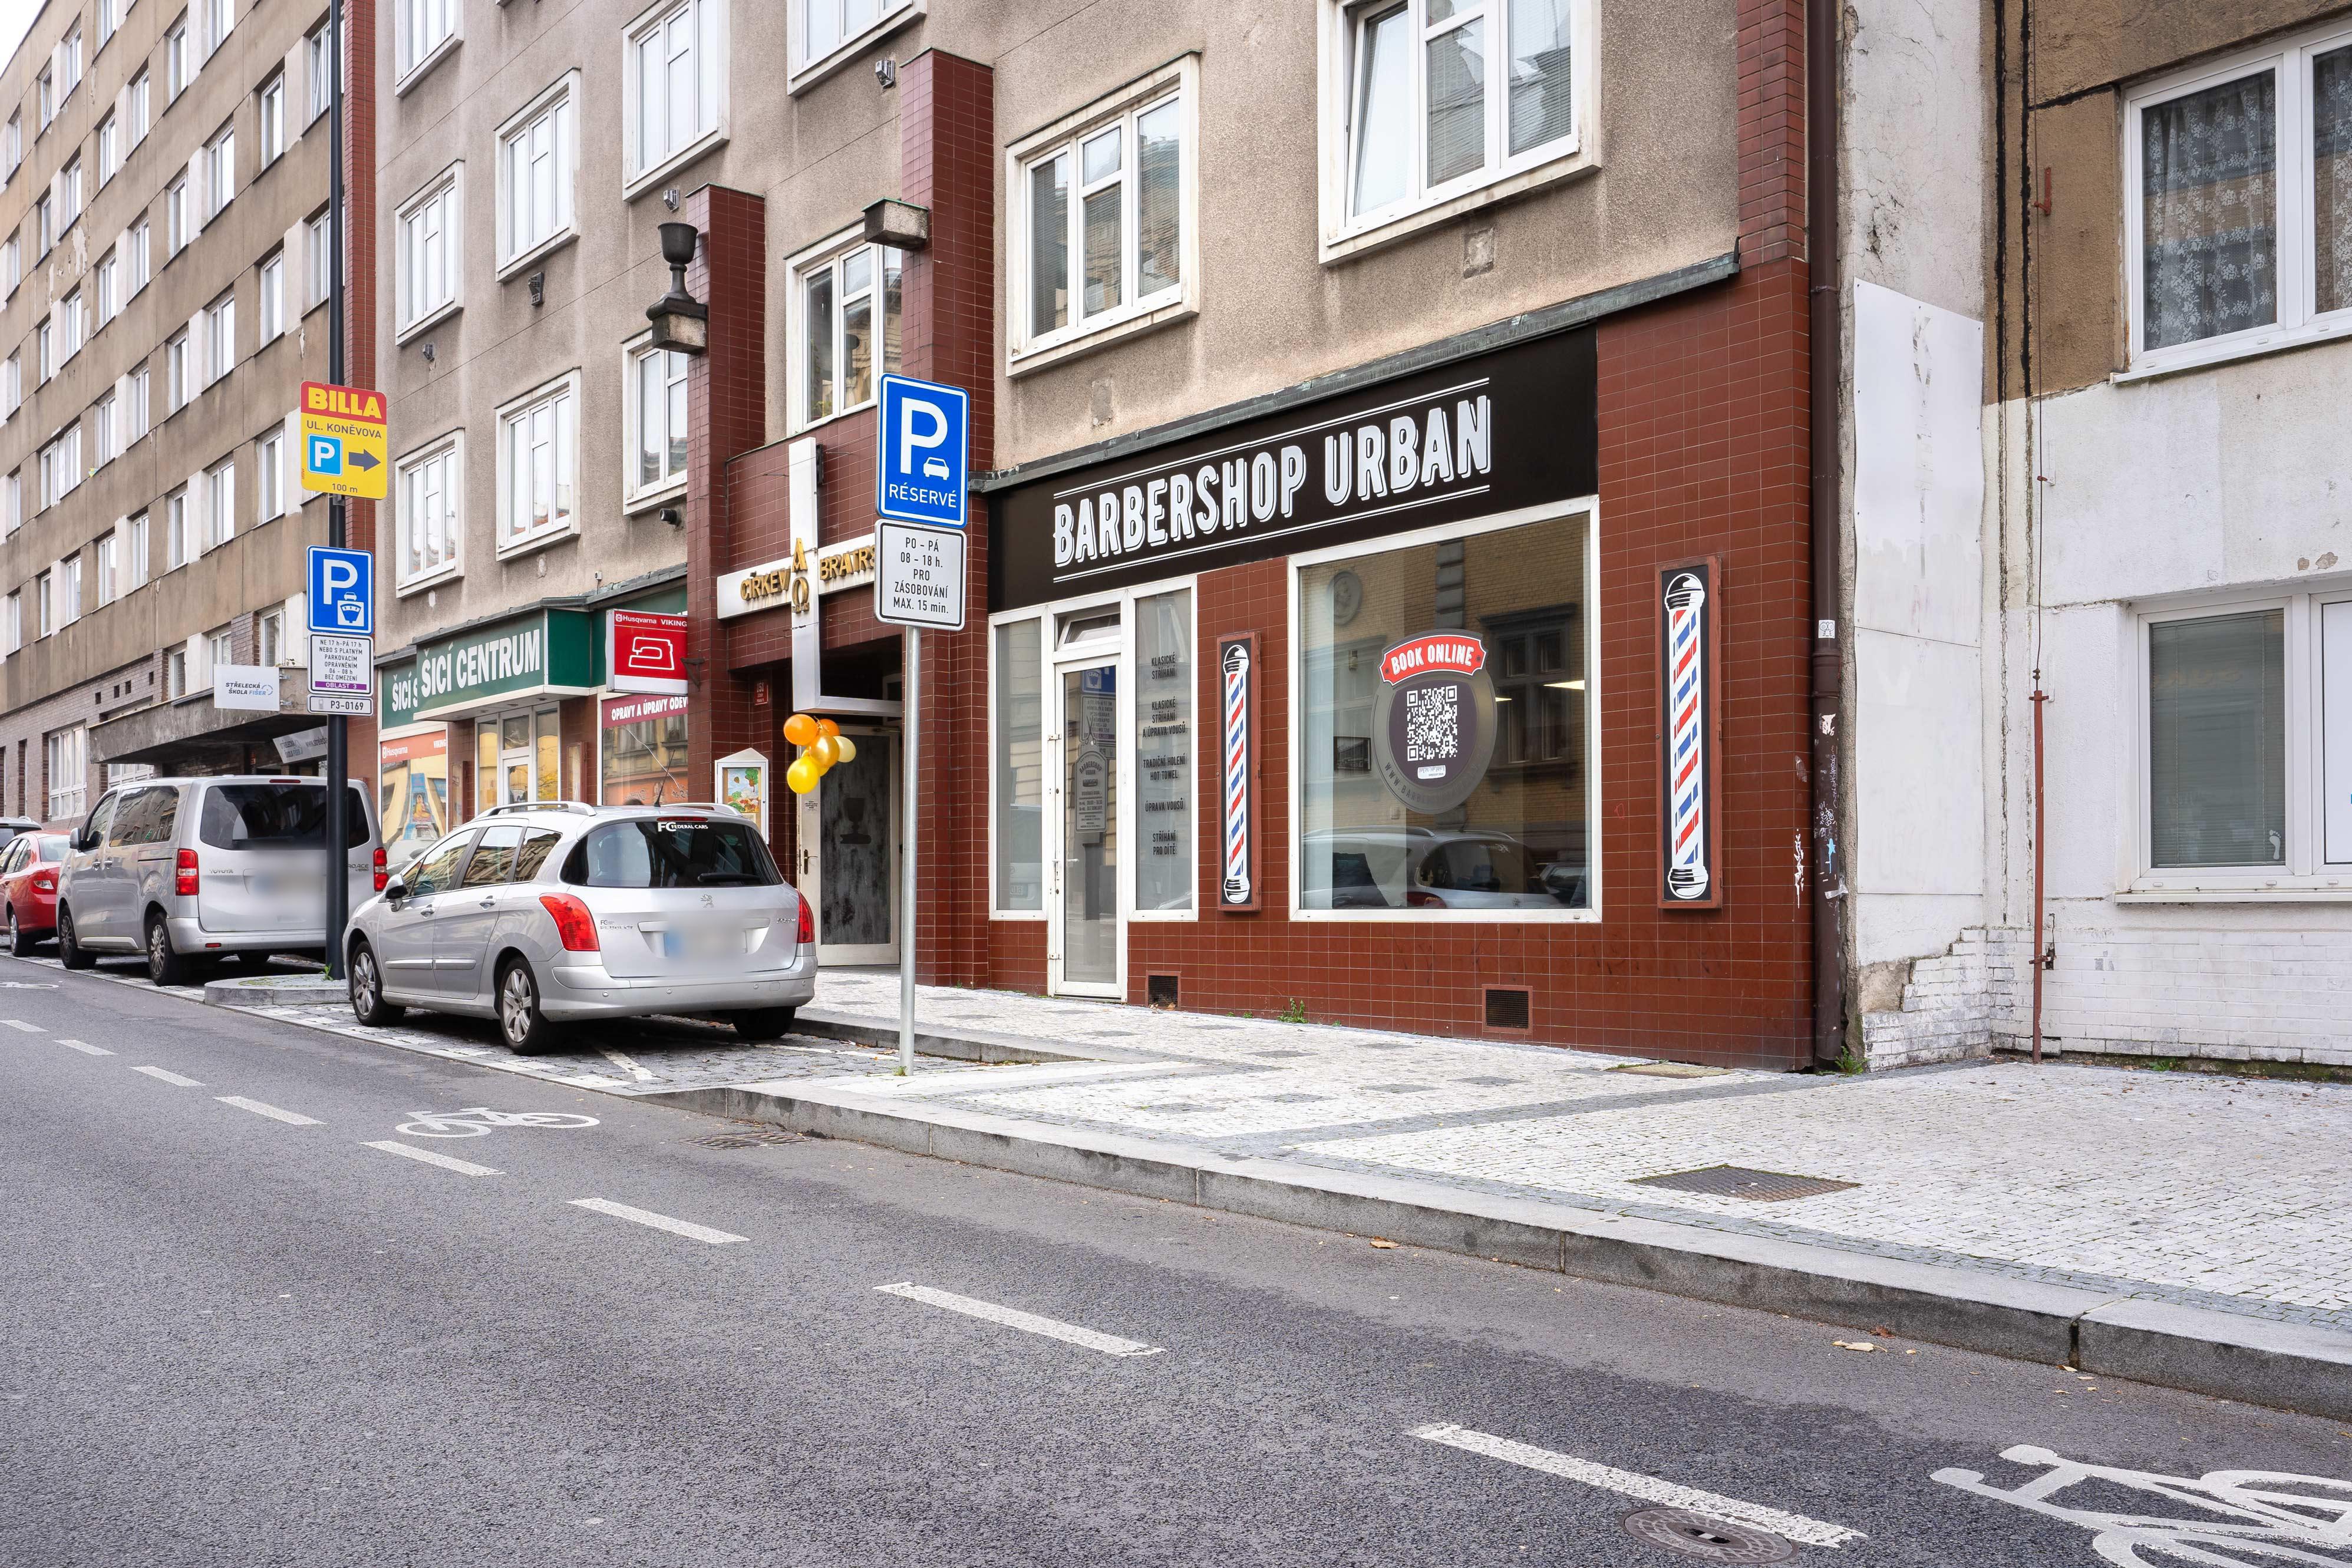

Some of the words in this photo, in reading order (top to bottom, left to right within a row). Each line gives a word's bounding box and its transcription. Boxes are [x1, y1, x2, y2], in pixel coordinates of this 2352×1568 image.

[308, 387, 382, 419] BILLA
[306, 420, 323, 430] UL.
[326, 423, 382, 439] KONĚVOVA
[900, 397, 948, 474] P
[315, 441, 335, 467] P
[332, 483, 347, 491] 100
[1053, 445, 1306, 568] BARBERSHOP
[1324, 395, 1492, 506] URBAN
[889, 482, 957, 508] RÉSERVÉ
[906, 537, 916, 549] PO
[928, 539, 939, 552] PÁ
[900, 552, 911, 563] 08
[922, 554, 932, 566] 18
[935, 556, 943, 568] h.
[323, 559, 358, 605] P
[913, 569, 930, 581] PRO
[895, 580, 949, 599] ZÁSOBOVÁNÍ
[893, 596, 914, 609] MAX.
[918, 599, 927, 611] 15
[931, 602, 949, 614] min.
[623, 615, 657, 624] Husqvarna
[661, 619, 687, 627] VIKING
[421, 642, 453, 698] ŠICÍ
[456, 629, 540, 689] CENTRUM
[1152, 652, 1176, 666] KLASICKÉ
[1391, 646, 1424, 675] BOOK
[1427, 643, 1475, 666] ONLINE
[1152, 665, 1175, 679] STŘÍHÁNÍ
[392, 671, 412, 712] ŠICÍ
[331, 700, 364, 710] P3-0169
[611, 705, 635, 721] OPRAVY
[637, 703, 642, 716] A
[643, 699, 668, 715] ÚPRAVY
[1152, 696, 1176, 711] KLASICKÉ
[1152, 710, 1175, 724] STŘÍHÁNÍ
[1143, 729, 1146, 738] A
[1147, 725, 1167, 737] ÚPRAVA
[1169, 721, 1186, 734] VOUSŮ
[387, 746, 408, 757] Husqvarna
[434, 739, 446, 748] VIKING
[1143, 755, 1166, 768] TRADIČNÍ
[1167, 753, 1185, 766] HOLENÍ
[1150, 771, 1160, 781] HOT
[1162, 770, 1178, 780] TOWEL
[1145, 800, 1165, 812] ÚPRAVA
[1166, 797, 1184, 810] VOUSŮ
[658, 821, 677, 832] FC
[1153, 830, 1176, 843] STŘÍHÁNÍ
[1153, 846, 1163, 856] PRO
[1164, 843, 1176, 855] DÍTĚ
